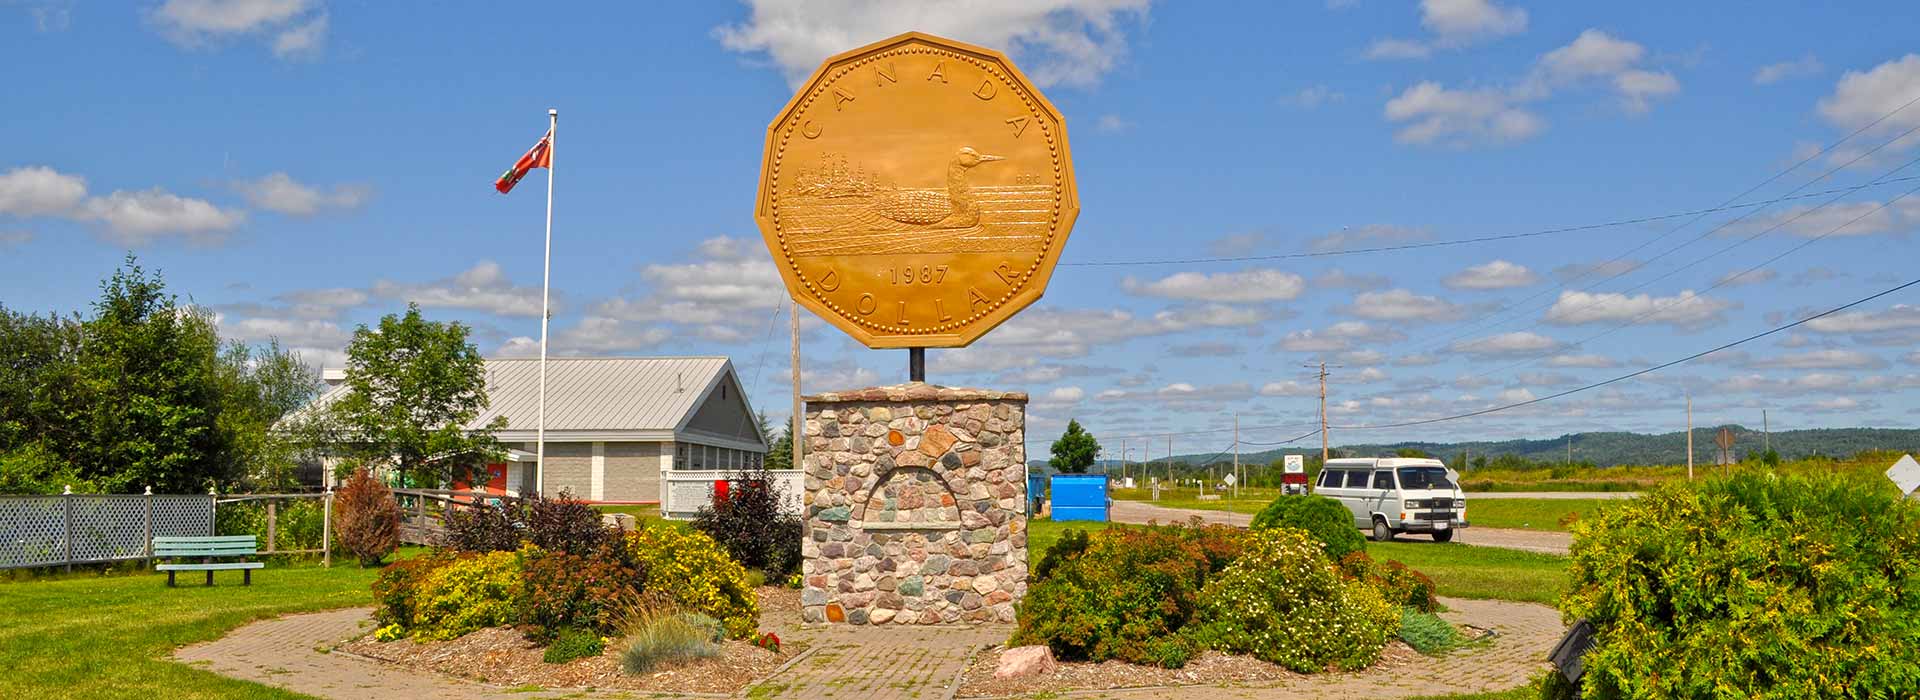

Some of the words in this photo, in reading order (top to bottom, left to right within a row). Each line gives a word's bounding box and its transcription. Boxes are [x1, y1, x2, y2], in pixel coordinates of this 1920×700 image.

[800, 61, 1031, 140] CANADA
[814, 261, 1021, 325] DOLLAR
[889, 264, 949, 284] 1987
